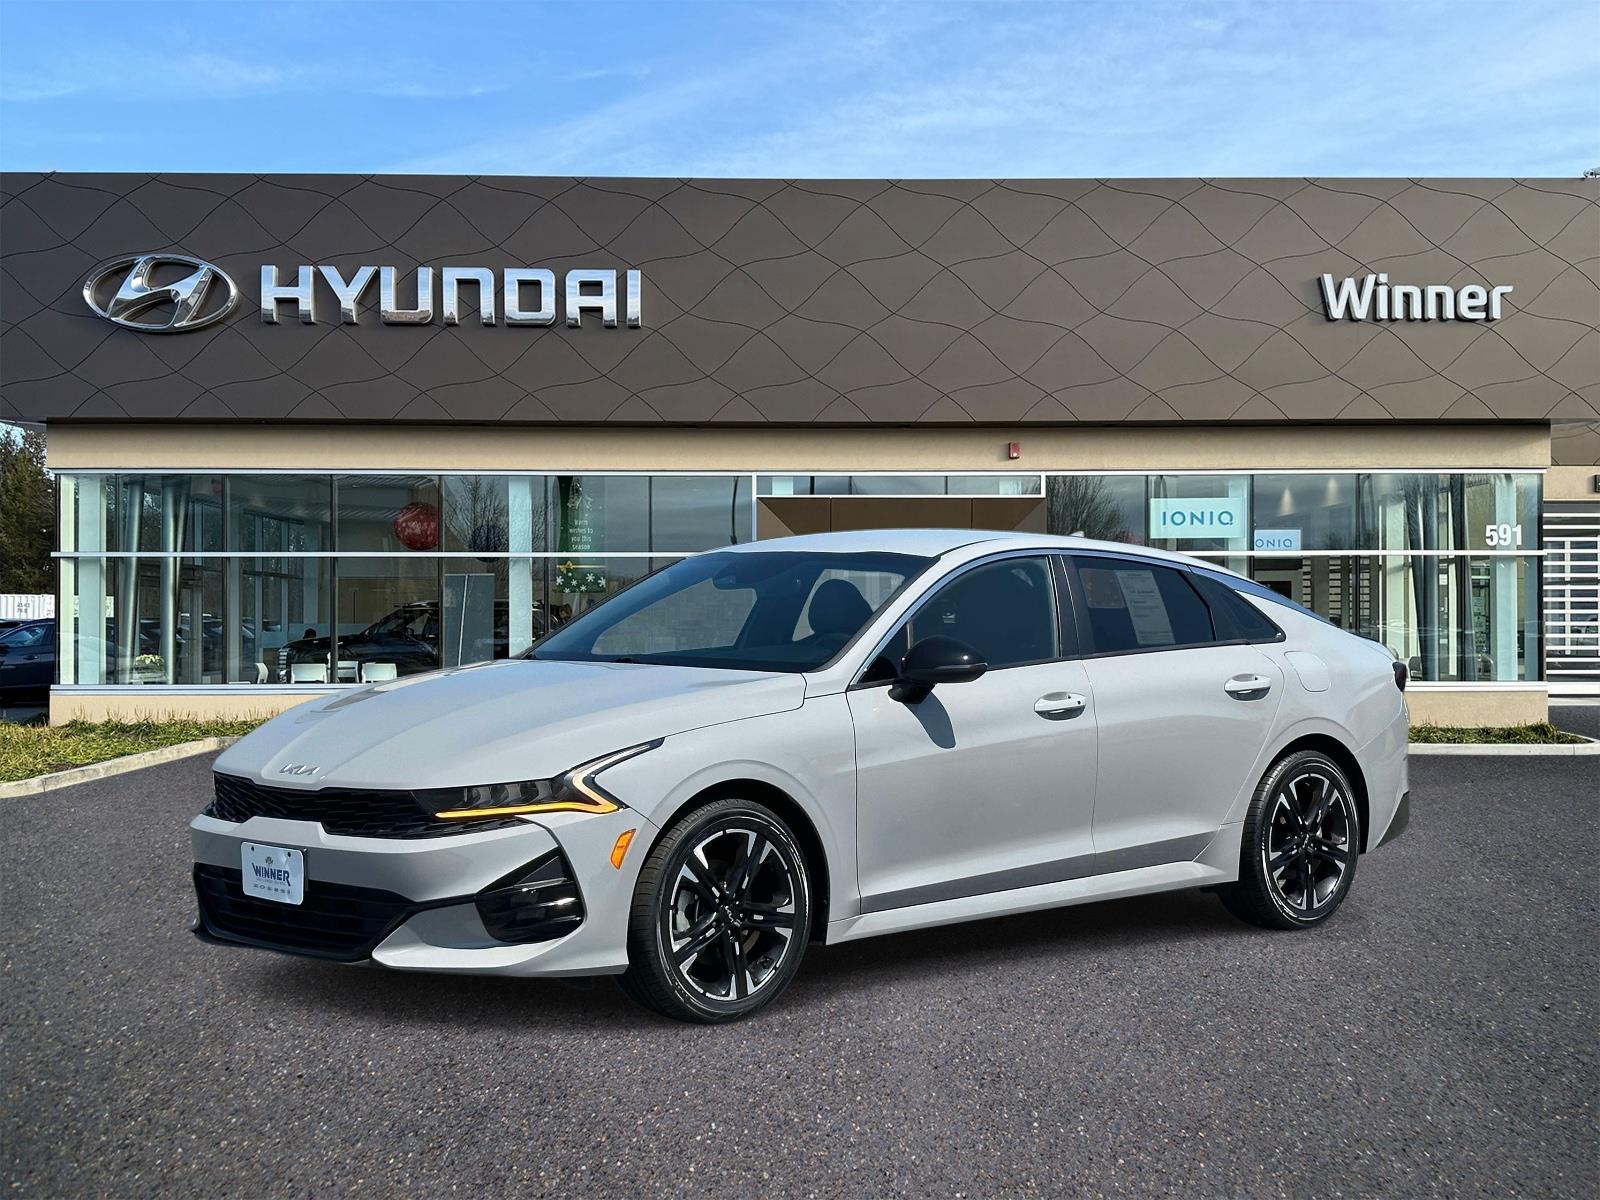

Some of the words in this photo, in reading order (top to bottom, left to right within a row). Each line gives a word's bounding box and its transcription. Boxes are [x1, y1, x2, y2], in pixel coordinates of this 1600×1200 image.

[260, 264, 642, 328] HYUNDAI
[1319, 272, 1515, 322] Winner
[1162, 510, 1234, 526] IONIQ
[1255, 538, 1293, 549] ONIQ
[1485, 523, 1522, 547] 591
[251, 862, 291, 887] WINNER
